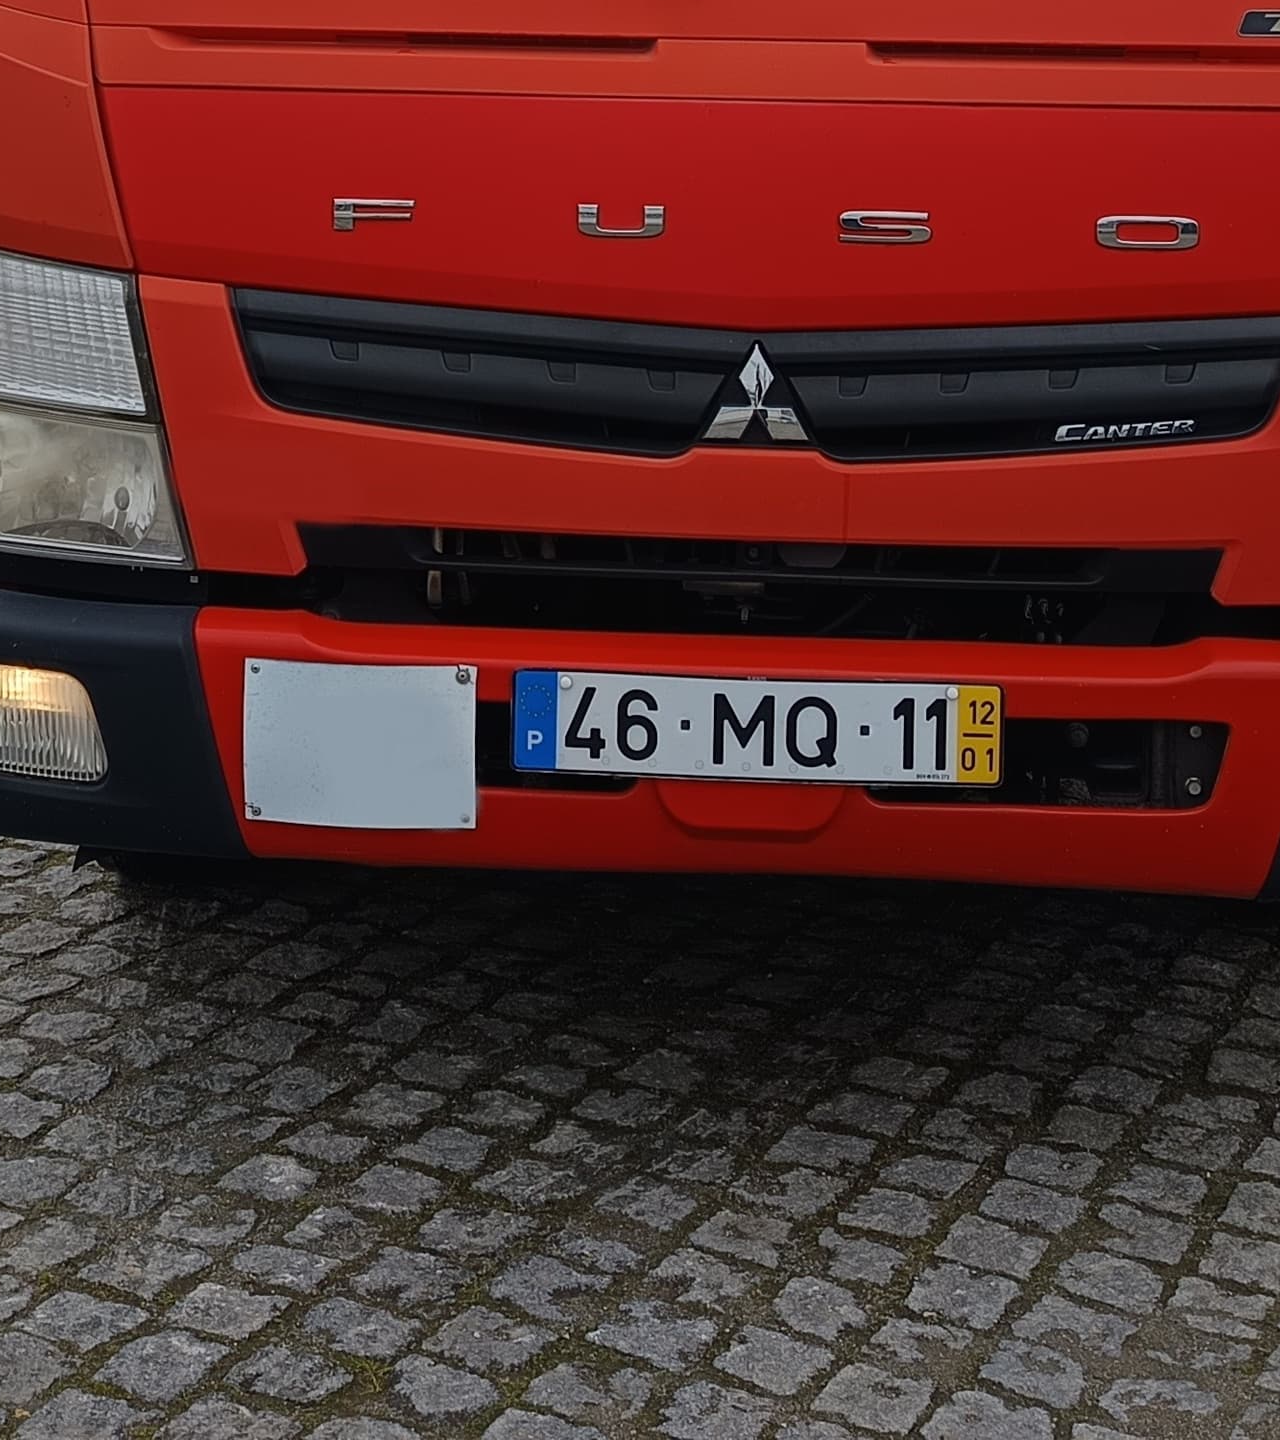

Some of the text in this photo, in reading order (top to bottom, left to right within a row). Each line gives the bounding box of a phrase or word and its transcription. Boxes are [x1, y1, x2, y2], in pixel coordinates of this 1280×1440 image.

[332, 197, 1199, 250] FUSO
[1054, 419, 1195, 442] CANTER
[968, 699, 996, 727] 12
[527, 729, 543, 751] P
